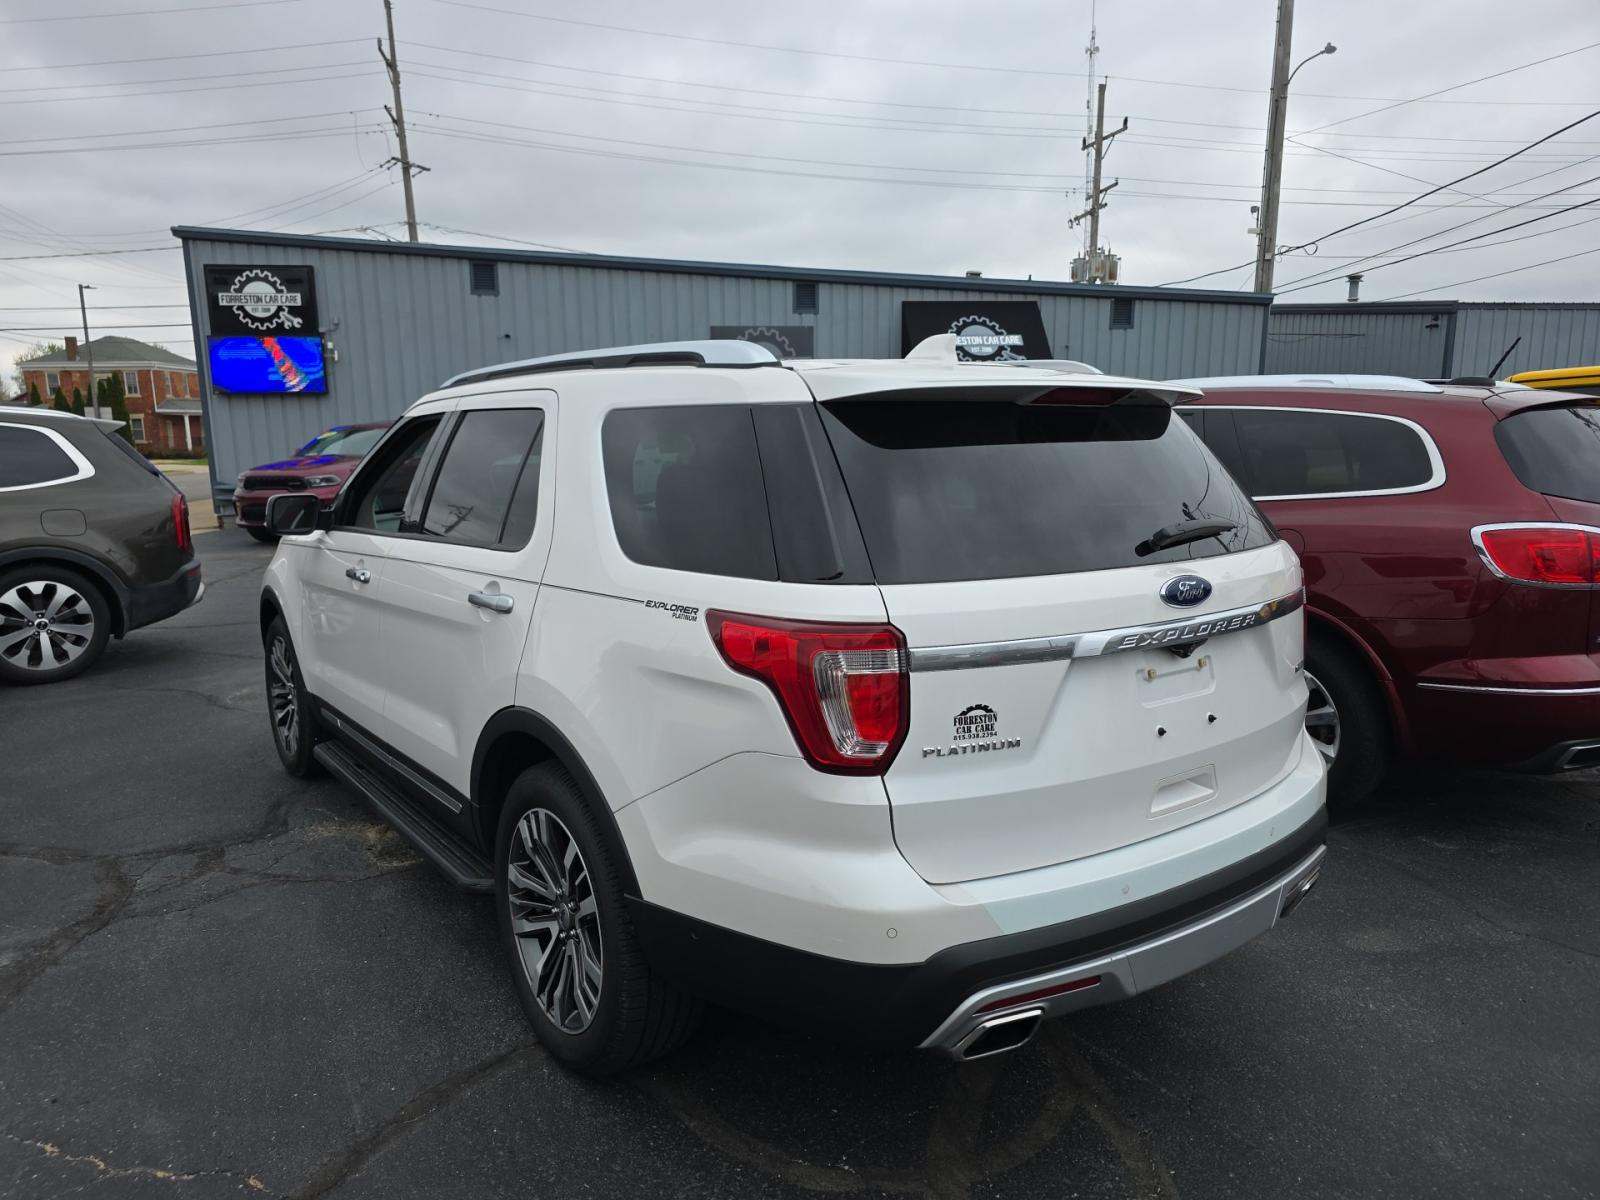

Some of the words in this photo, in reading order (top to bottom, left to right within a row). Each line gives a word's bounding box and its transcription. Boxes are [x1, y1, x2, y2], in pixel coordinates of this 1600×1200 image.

[220, 294, 263, 304] FORRESTON
[264, 294, 279, 304] CAR
[280, 295, 298, 305] CARE
[956, 336, 983, 344] ESTON
[984, 336, 999, 344] CAR
[1000, 335, 1019, 344] CARE
[1177, 581, 1204, 600] Ford
[645, 600, 699, 615] EXPLORER
[672, 612, 698, 622] PLATINUM
[1118, 614, 1256, 649] EXPLORER
[953, 713, 998, 726] FORRESTON
[956, 725, 972, 735] CAR
[975, 723, 995, 733] CARE
[922, 737, 1021, 758] PLATINUM
